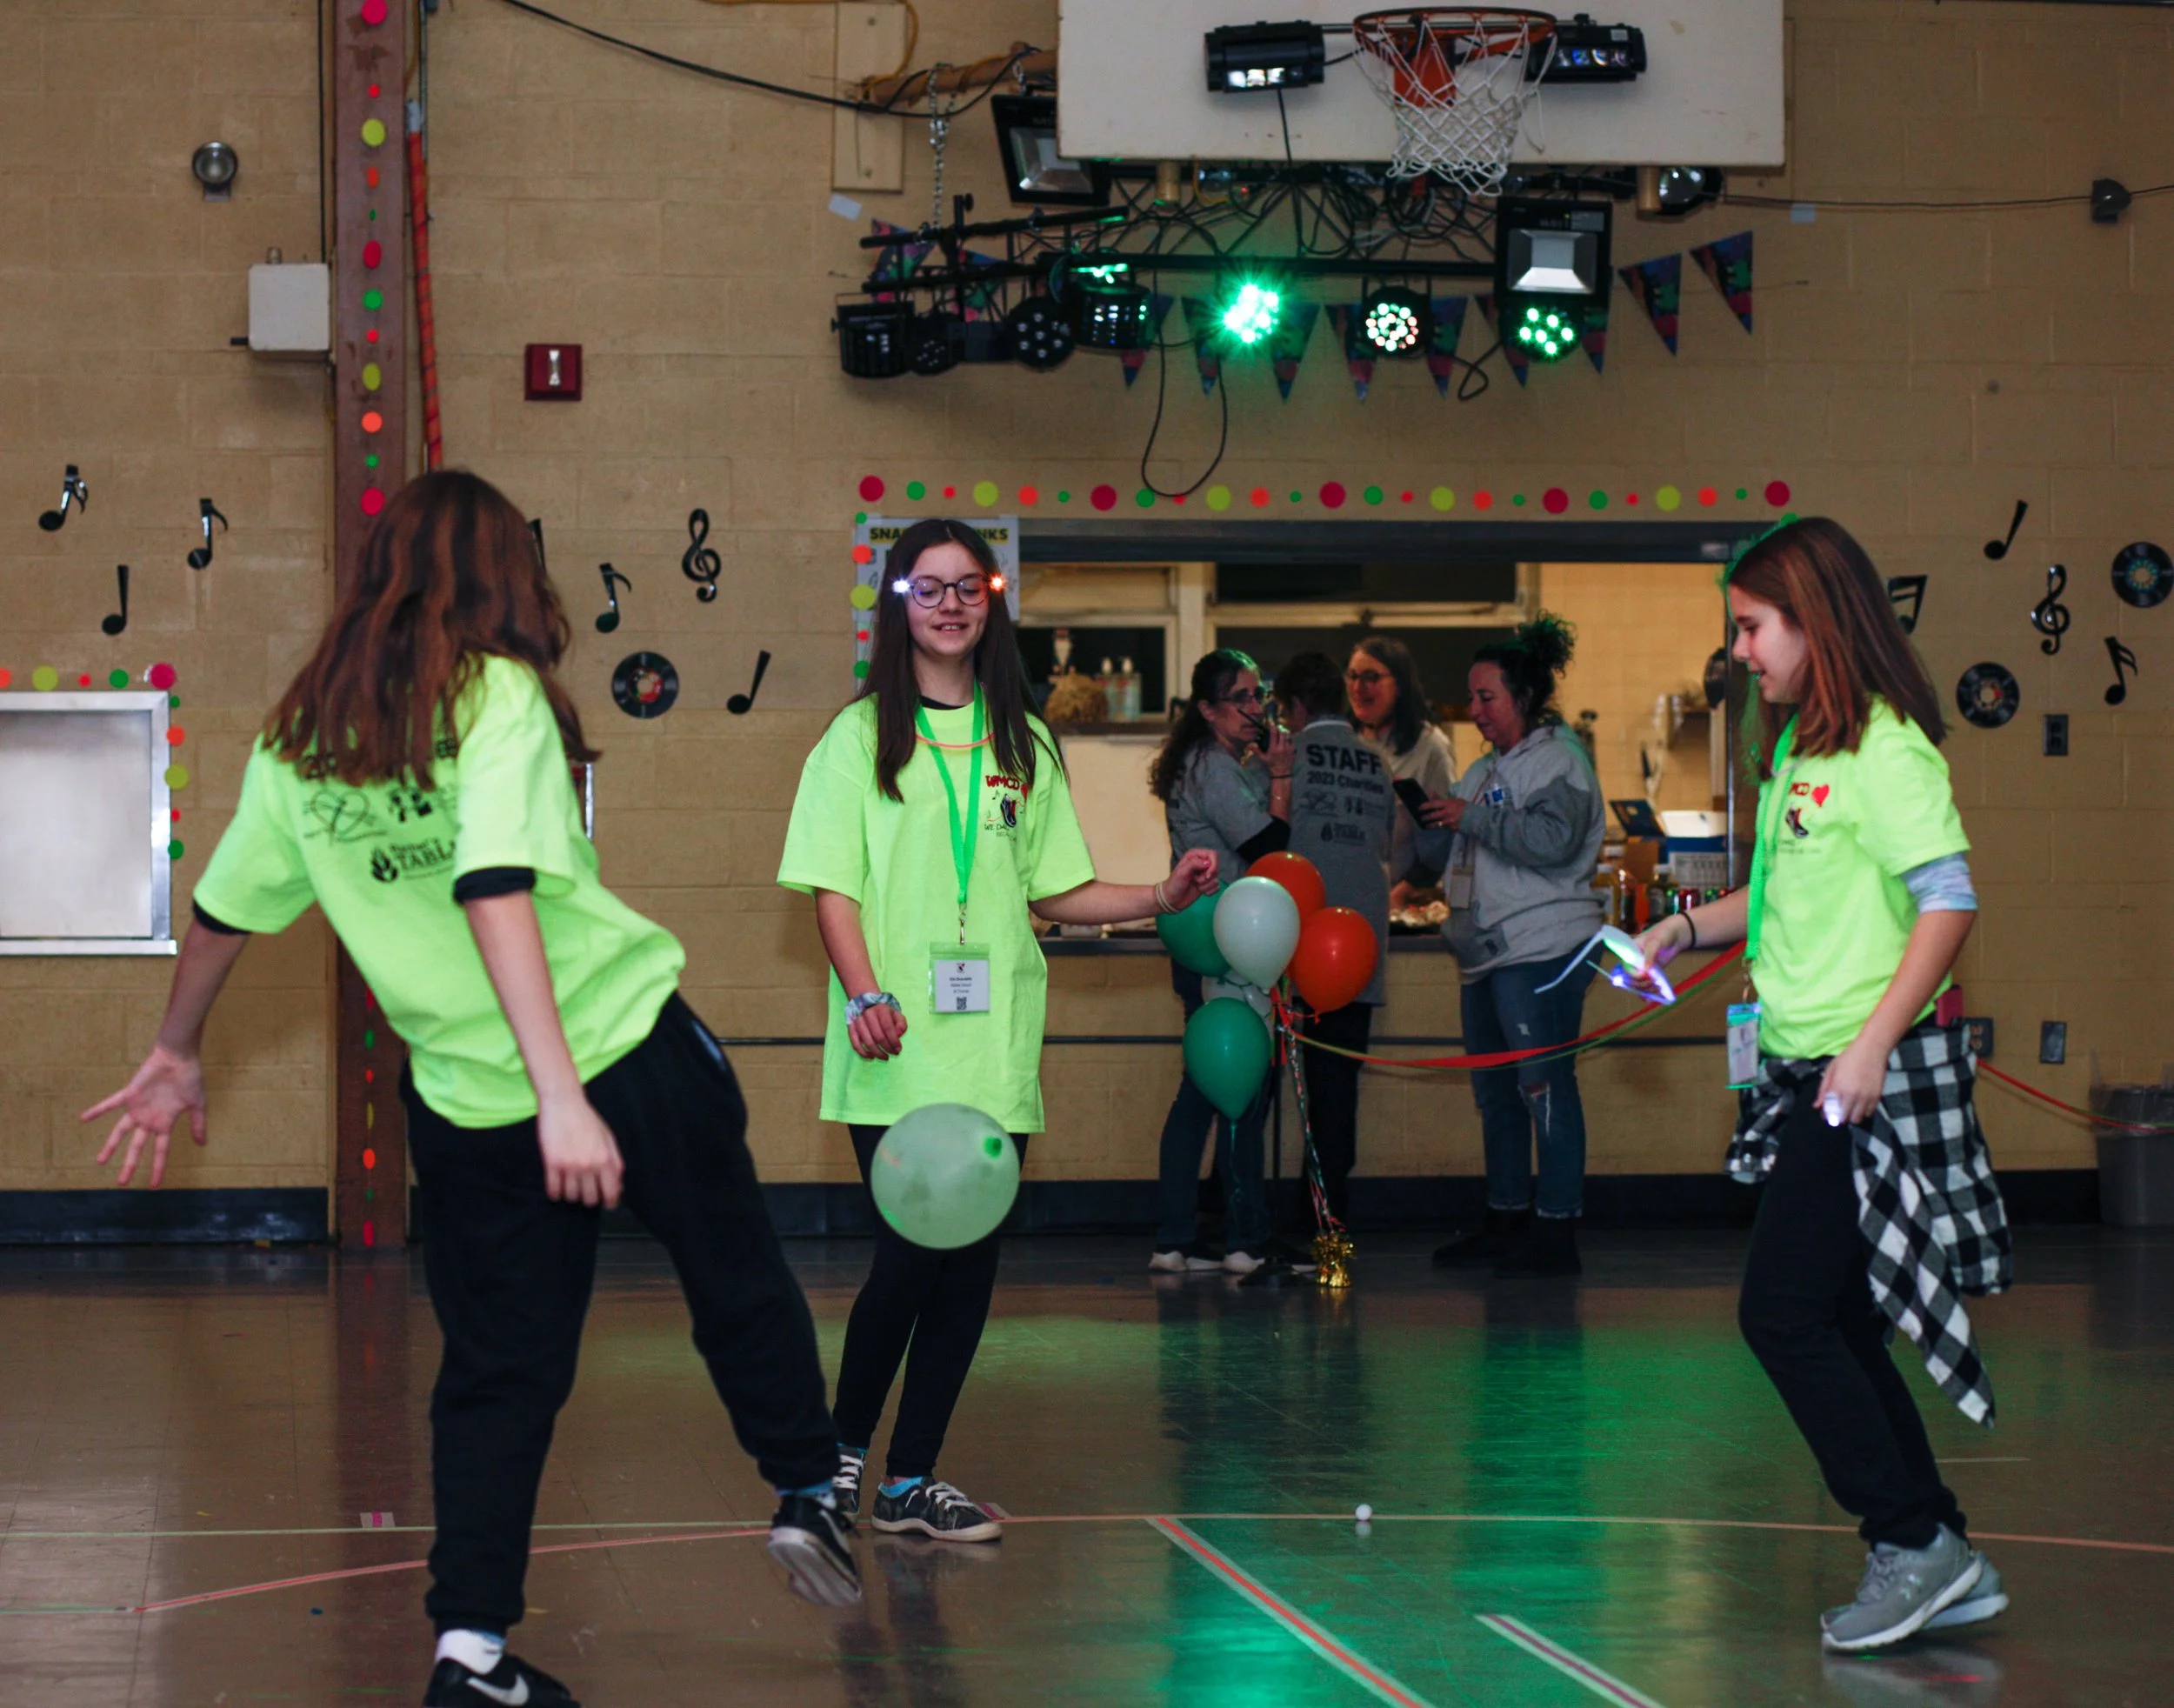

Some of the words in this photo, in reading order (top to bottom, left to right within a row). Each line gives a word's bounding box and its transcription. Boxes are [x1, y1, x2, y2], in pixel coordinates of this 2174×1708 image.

[870, 527, 903, 540] SNA
[1305, 743, 1383, 775] STAFF
[984, 774, 1020, 791] WMCD
[396, 838, 457, 871] TABL
